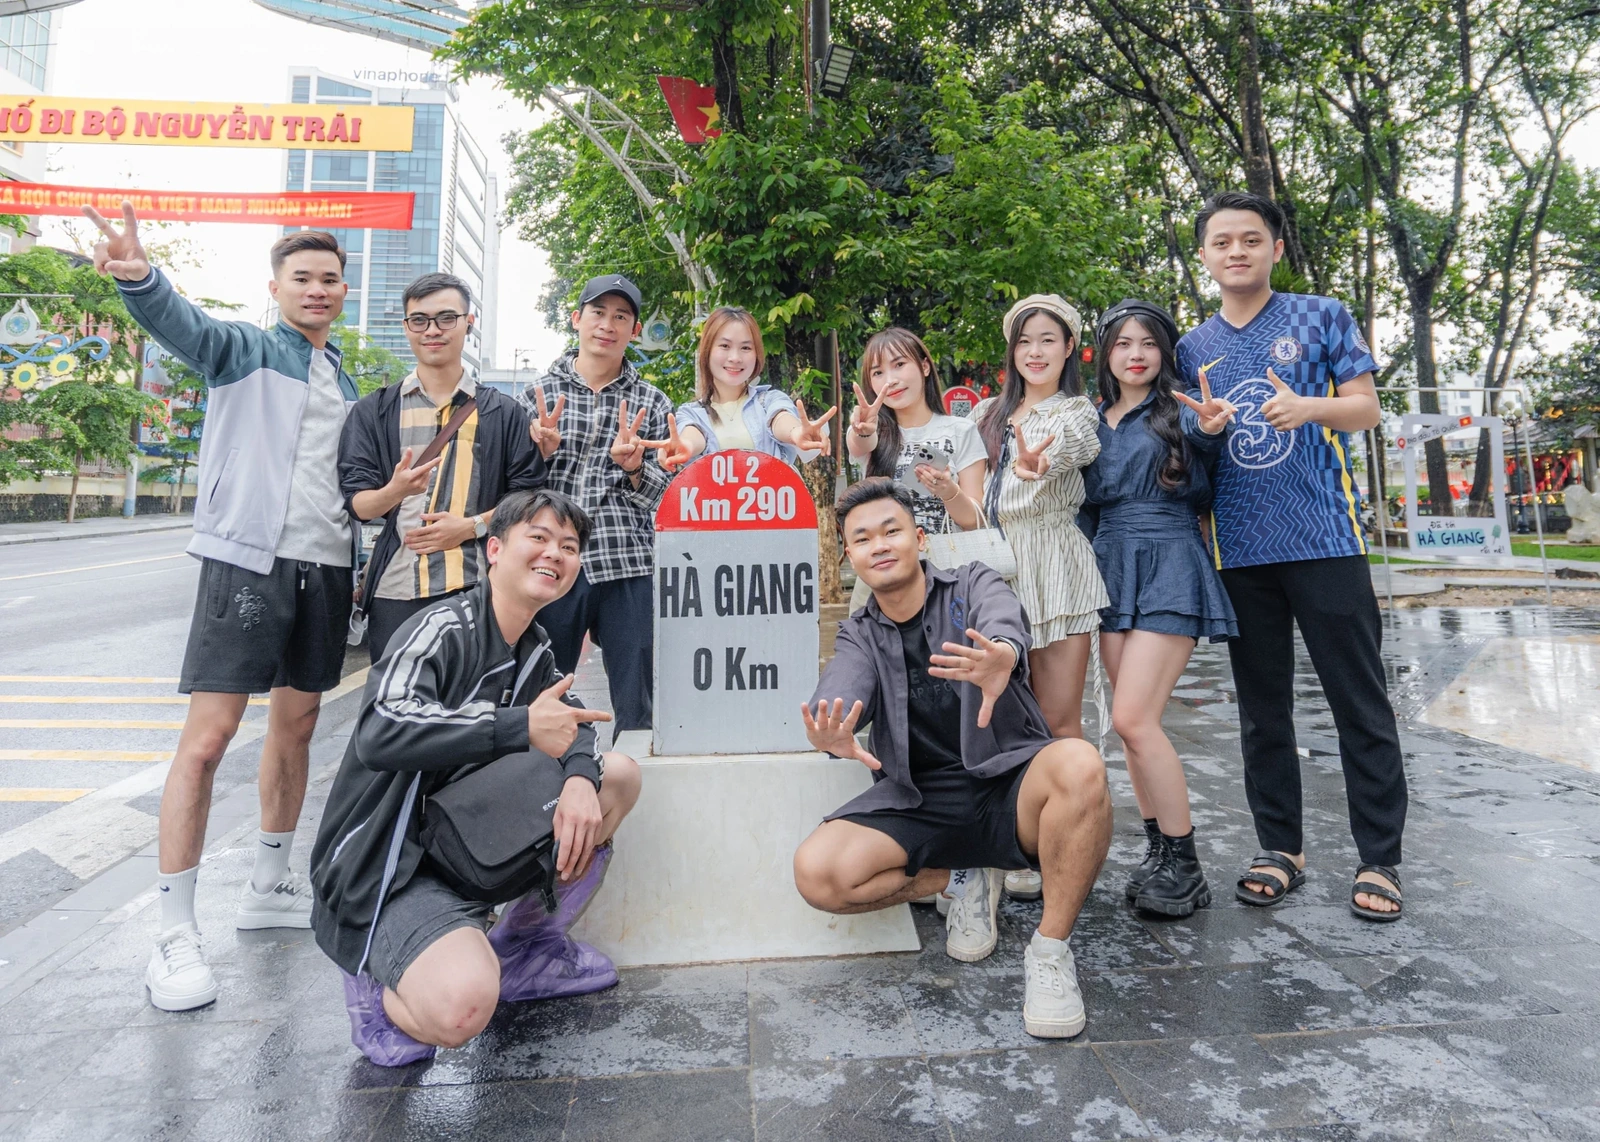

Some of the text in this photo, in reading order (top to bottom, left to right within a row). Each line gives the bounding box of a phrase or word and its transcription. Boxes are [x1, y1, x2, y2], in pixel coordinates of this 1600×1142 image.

[39, 109, 76, 135] ĐI
[81, 105, 127, 141] BỘ
[133, 104, 275, 141] NGUYỄN
[200, 197, 242, 215] NAM
[711, 455, 759, 485] QL 2
[680, 486, 796, 522] Km 290
[1417, 527, 1485, 545] HÀ GIANG
[659, 552, 813, 618] HÀ GIANG
[693, 646, 778, 691] 0 Km
